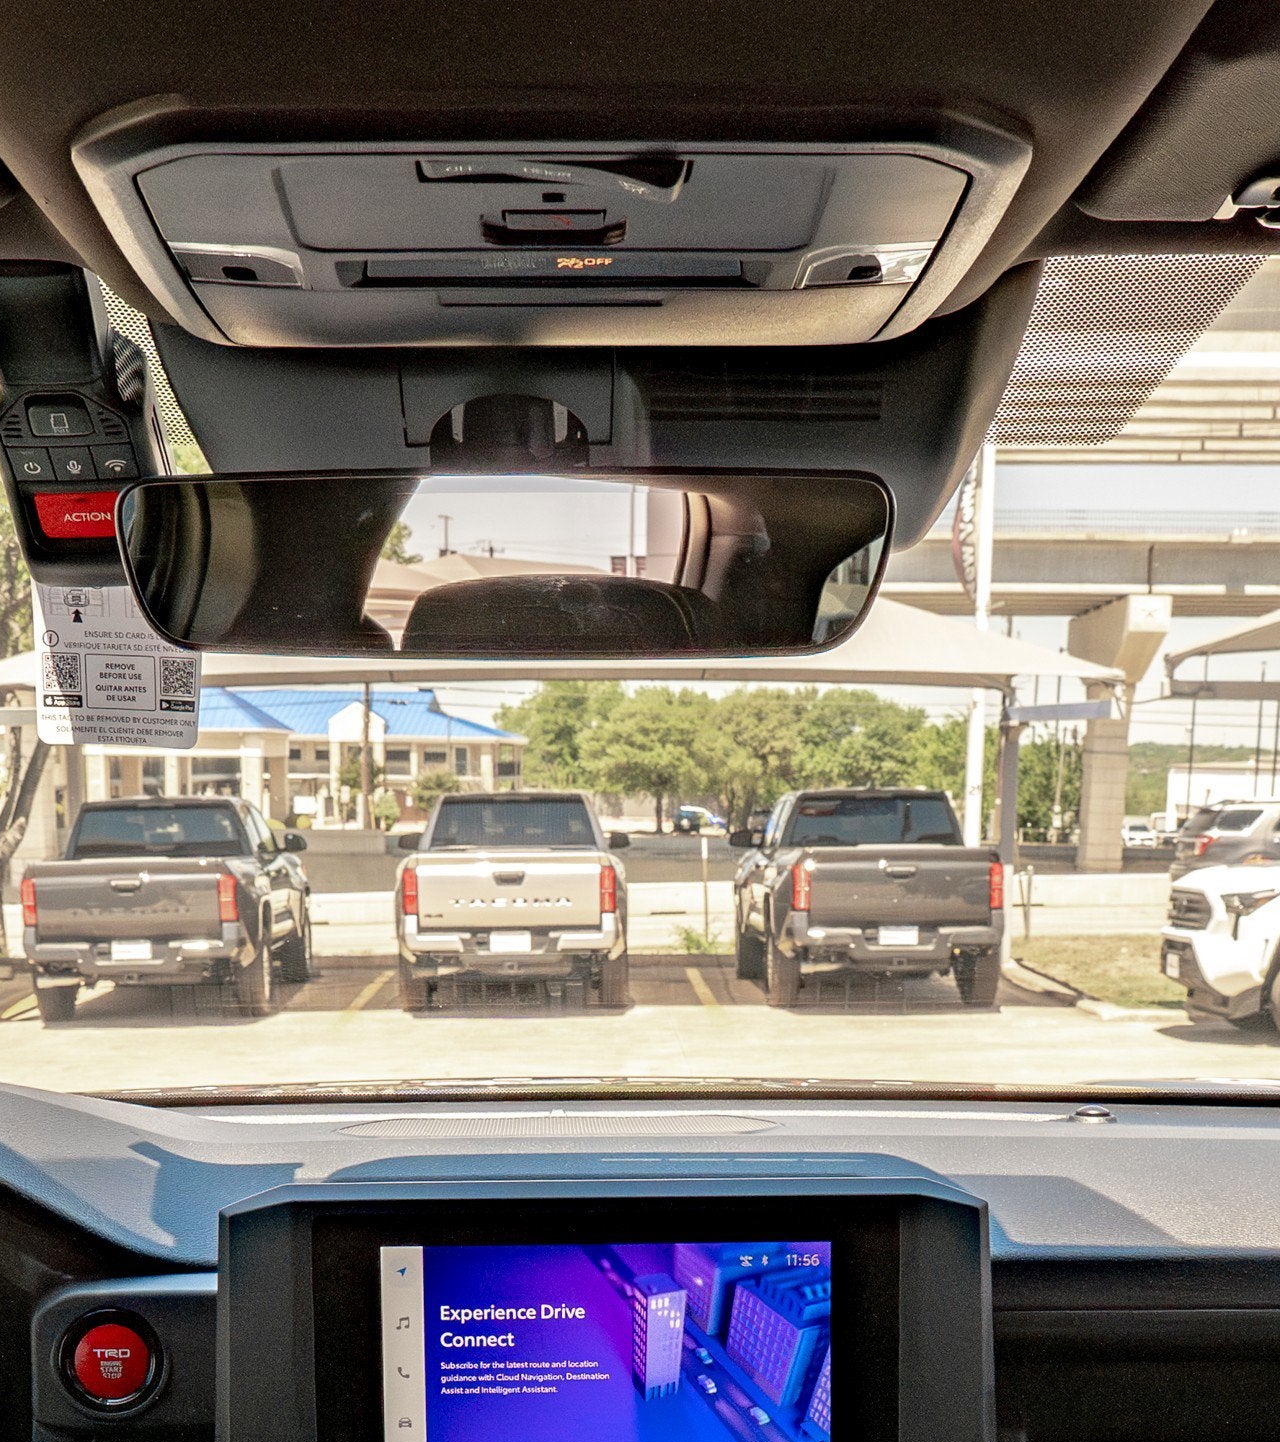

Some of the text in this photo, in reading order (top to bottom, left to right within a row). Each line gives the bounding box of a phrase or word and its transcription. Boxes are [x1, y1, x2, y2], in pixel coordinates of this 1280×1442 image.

[583, 258, 614, 266] OFF
[63, 511, 112, 523] ACTION
[84, 630, 113, 639] ENSURE
[114, 631, 123, 639] SD
[64, 642, 101, 650] VERIFIQUE
[134, 643, 142, 651] SD
[105, 663, 135, 671] REMOVE
[99, 672, 142, 680] BEFORE USE
[95, 685, 147, 693] QUITAR ANTES
[106, 694, 116, 702] DE
[96, 715, 131, 724] REMOVED
[142, 717, 178, 726] CUSTOMER
[179, 719, 196, 727] ONLY
[56, 726, 97, 734] SOLAMENTE
[108, 727, 135, 735] CLIENTE
[136, 728, 153, 736] DEBE
[154, 730, 184, 738] REMOVER
[97, 735, 147, 744] ESTA ETIQUETA
[448, 897, 573, 908] TACOMA
[785, 1254, 820, 1267] 11:56
[439, 1303, 586, 1324] Experience Drive
[439, 1332, 515, 1348] Connect
[92, 1348, 131, 1359] TRD
[440, 1360, 599, 1370] Subscribe for the latest route and location
[440, 1374, 477, 1384] guidance
[496, 1373, 520, 1381] Cloud
[521, 1373, 565, 1383] Navigation,
[565, 1372, 610, 1381] Destination
[441, 1385, 559, 1396] Assist and Intelligent Assistant.
